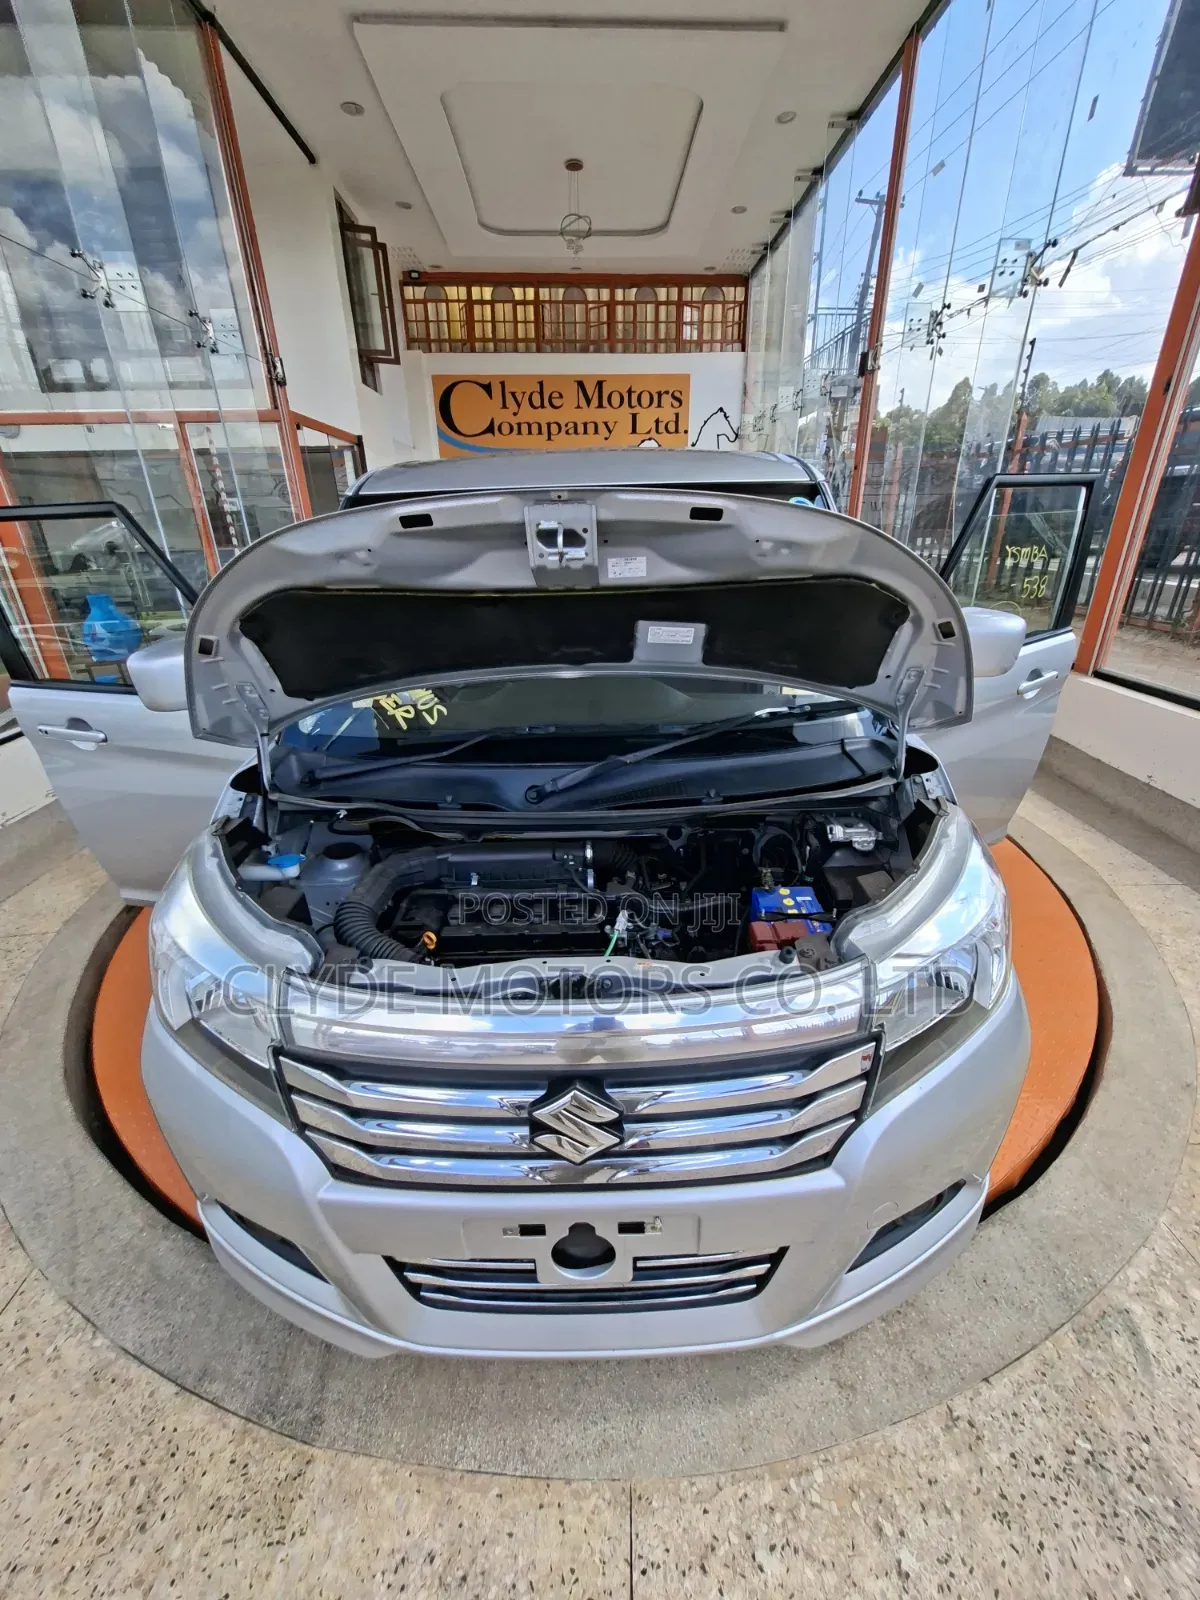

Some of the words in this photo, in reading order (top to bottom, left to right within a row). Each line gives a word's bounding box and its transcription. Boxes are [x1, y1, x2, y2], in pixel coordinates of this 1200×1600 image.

[439, 380, 565, 438] Clyde
[573, 380, 684, 410] Motors
[629, 412, 689, 435] Ltd.
[1021, 575, 1049, 599] 538
